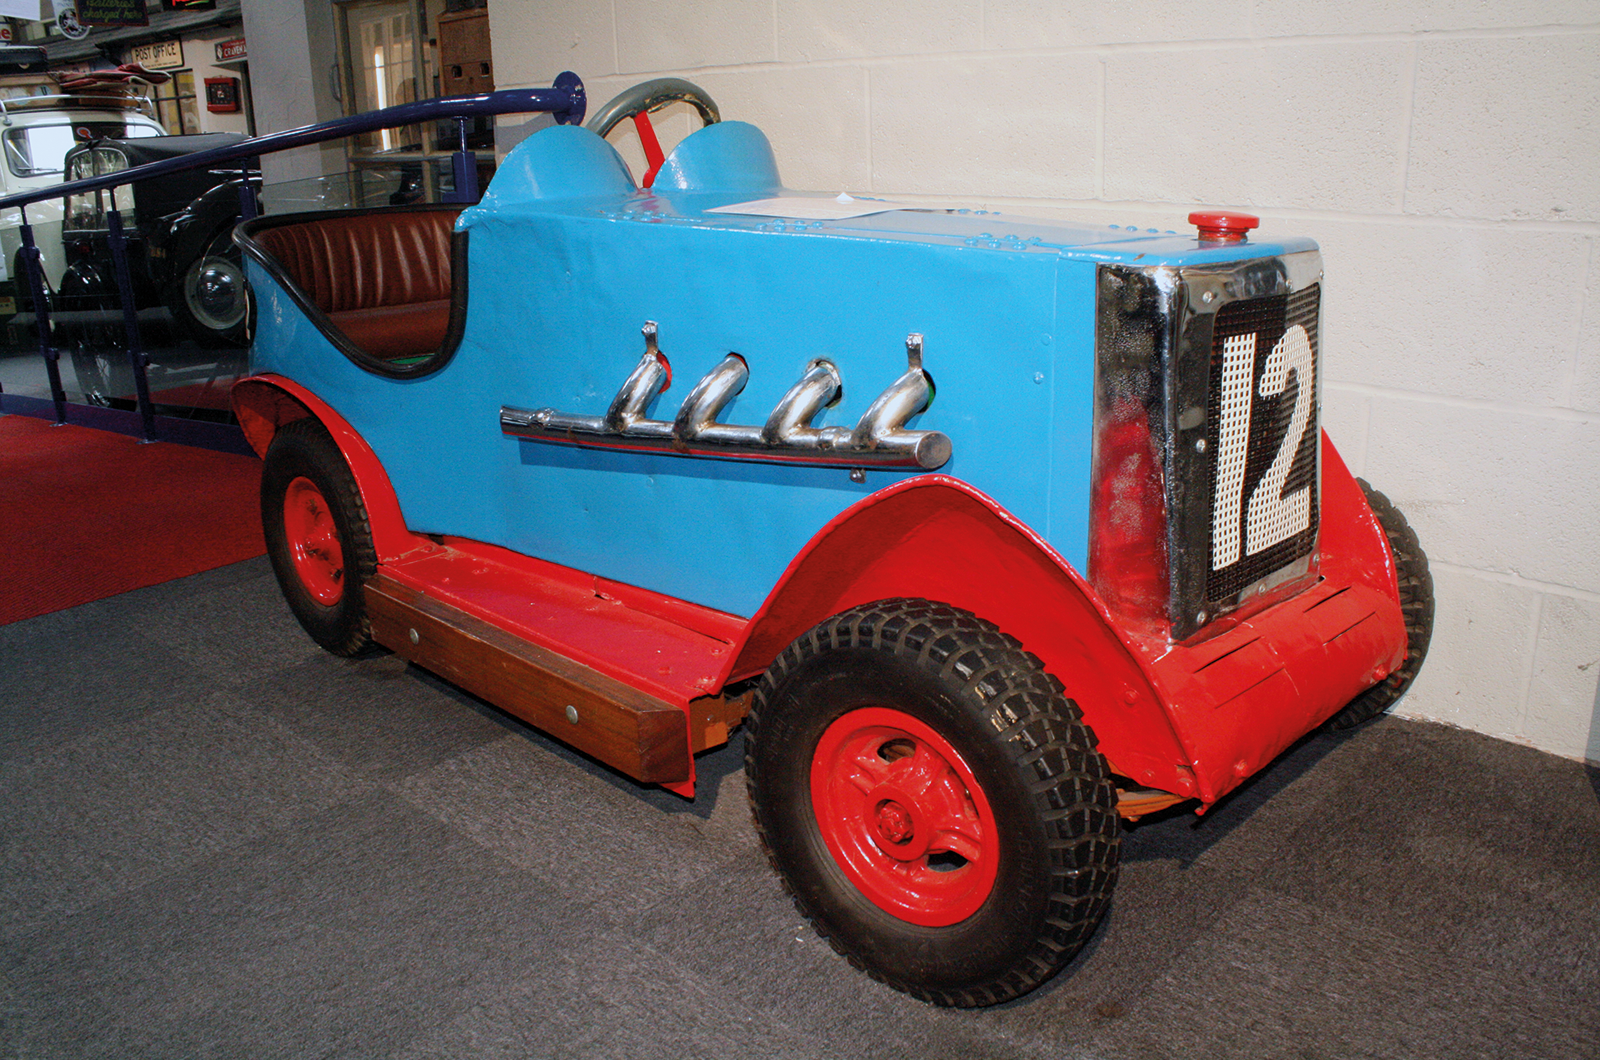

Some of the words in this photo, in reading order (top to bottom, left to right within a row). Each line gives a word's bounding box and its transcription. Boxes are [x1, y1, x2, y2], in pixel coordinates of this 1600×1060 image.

[82, 8, 121, 23] charged
[123, 8, 144, 19] here
[134, 47, 152, 61] POST
[153, 43, 177, 58] OFFICE
[1213, 325, 1313, 571] 12
